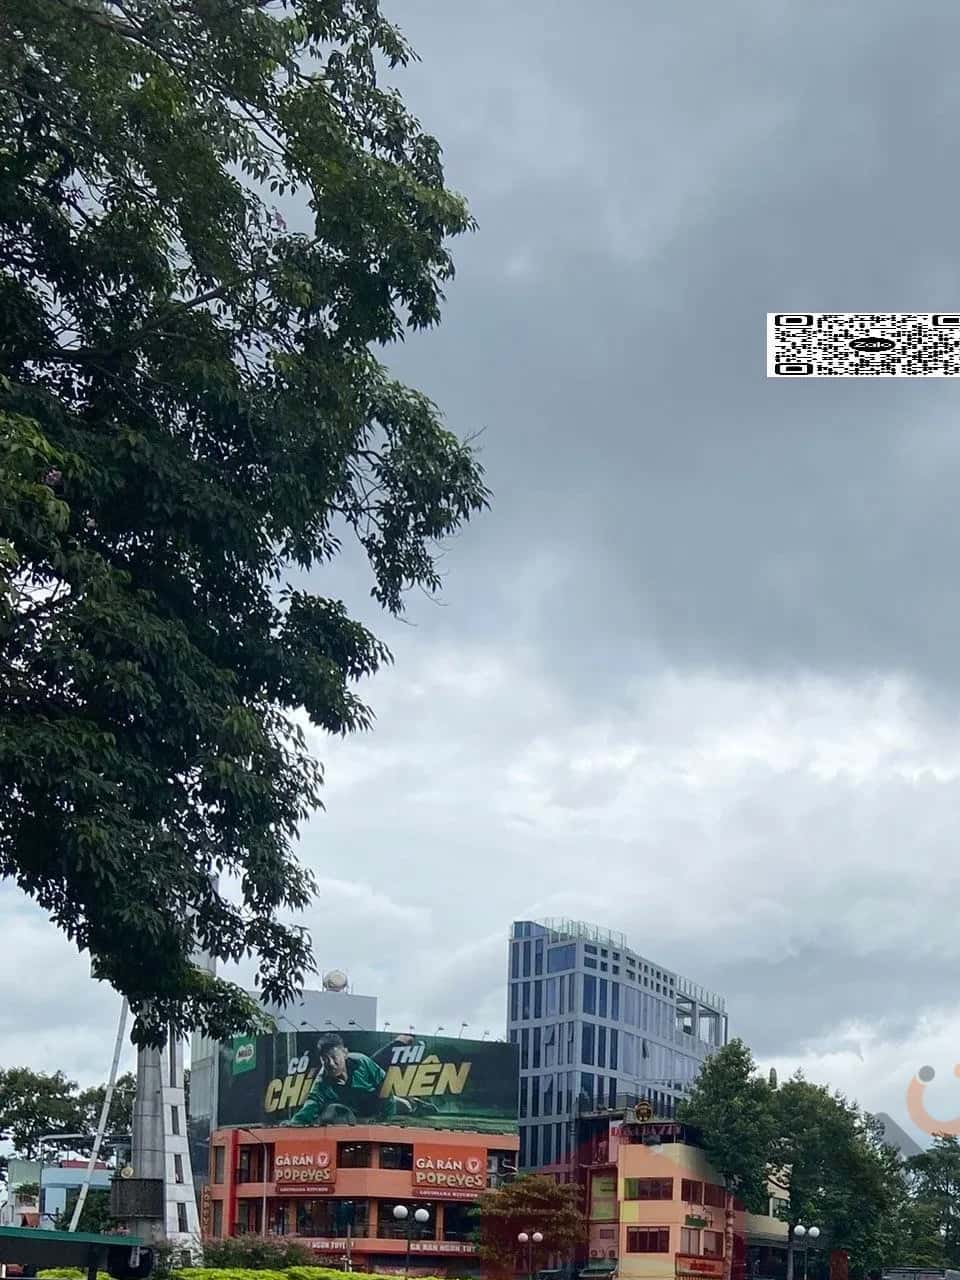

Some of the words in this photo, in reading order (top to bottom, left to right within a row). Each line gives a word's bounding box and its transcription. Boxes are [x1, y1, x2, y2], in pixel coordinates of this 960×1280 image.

[287, 1050, 310, 1074] CÓ
[391, 1041, 425, 1064] THÌ
[379, 1055, 473, 1099] NÊN
[416, 1156, 434, 1169] GÀ
[436, 1157, 463, 1170] RÁN
